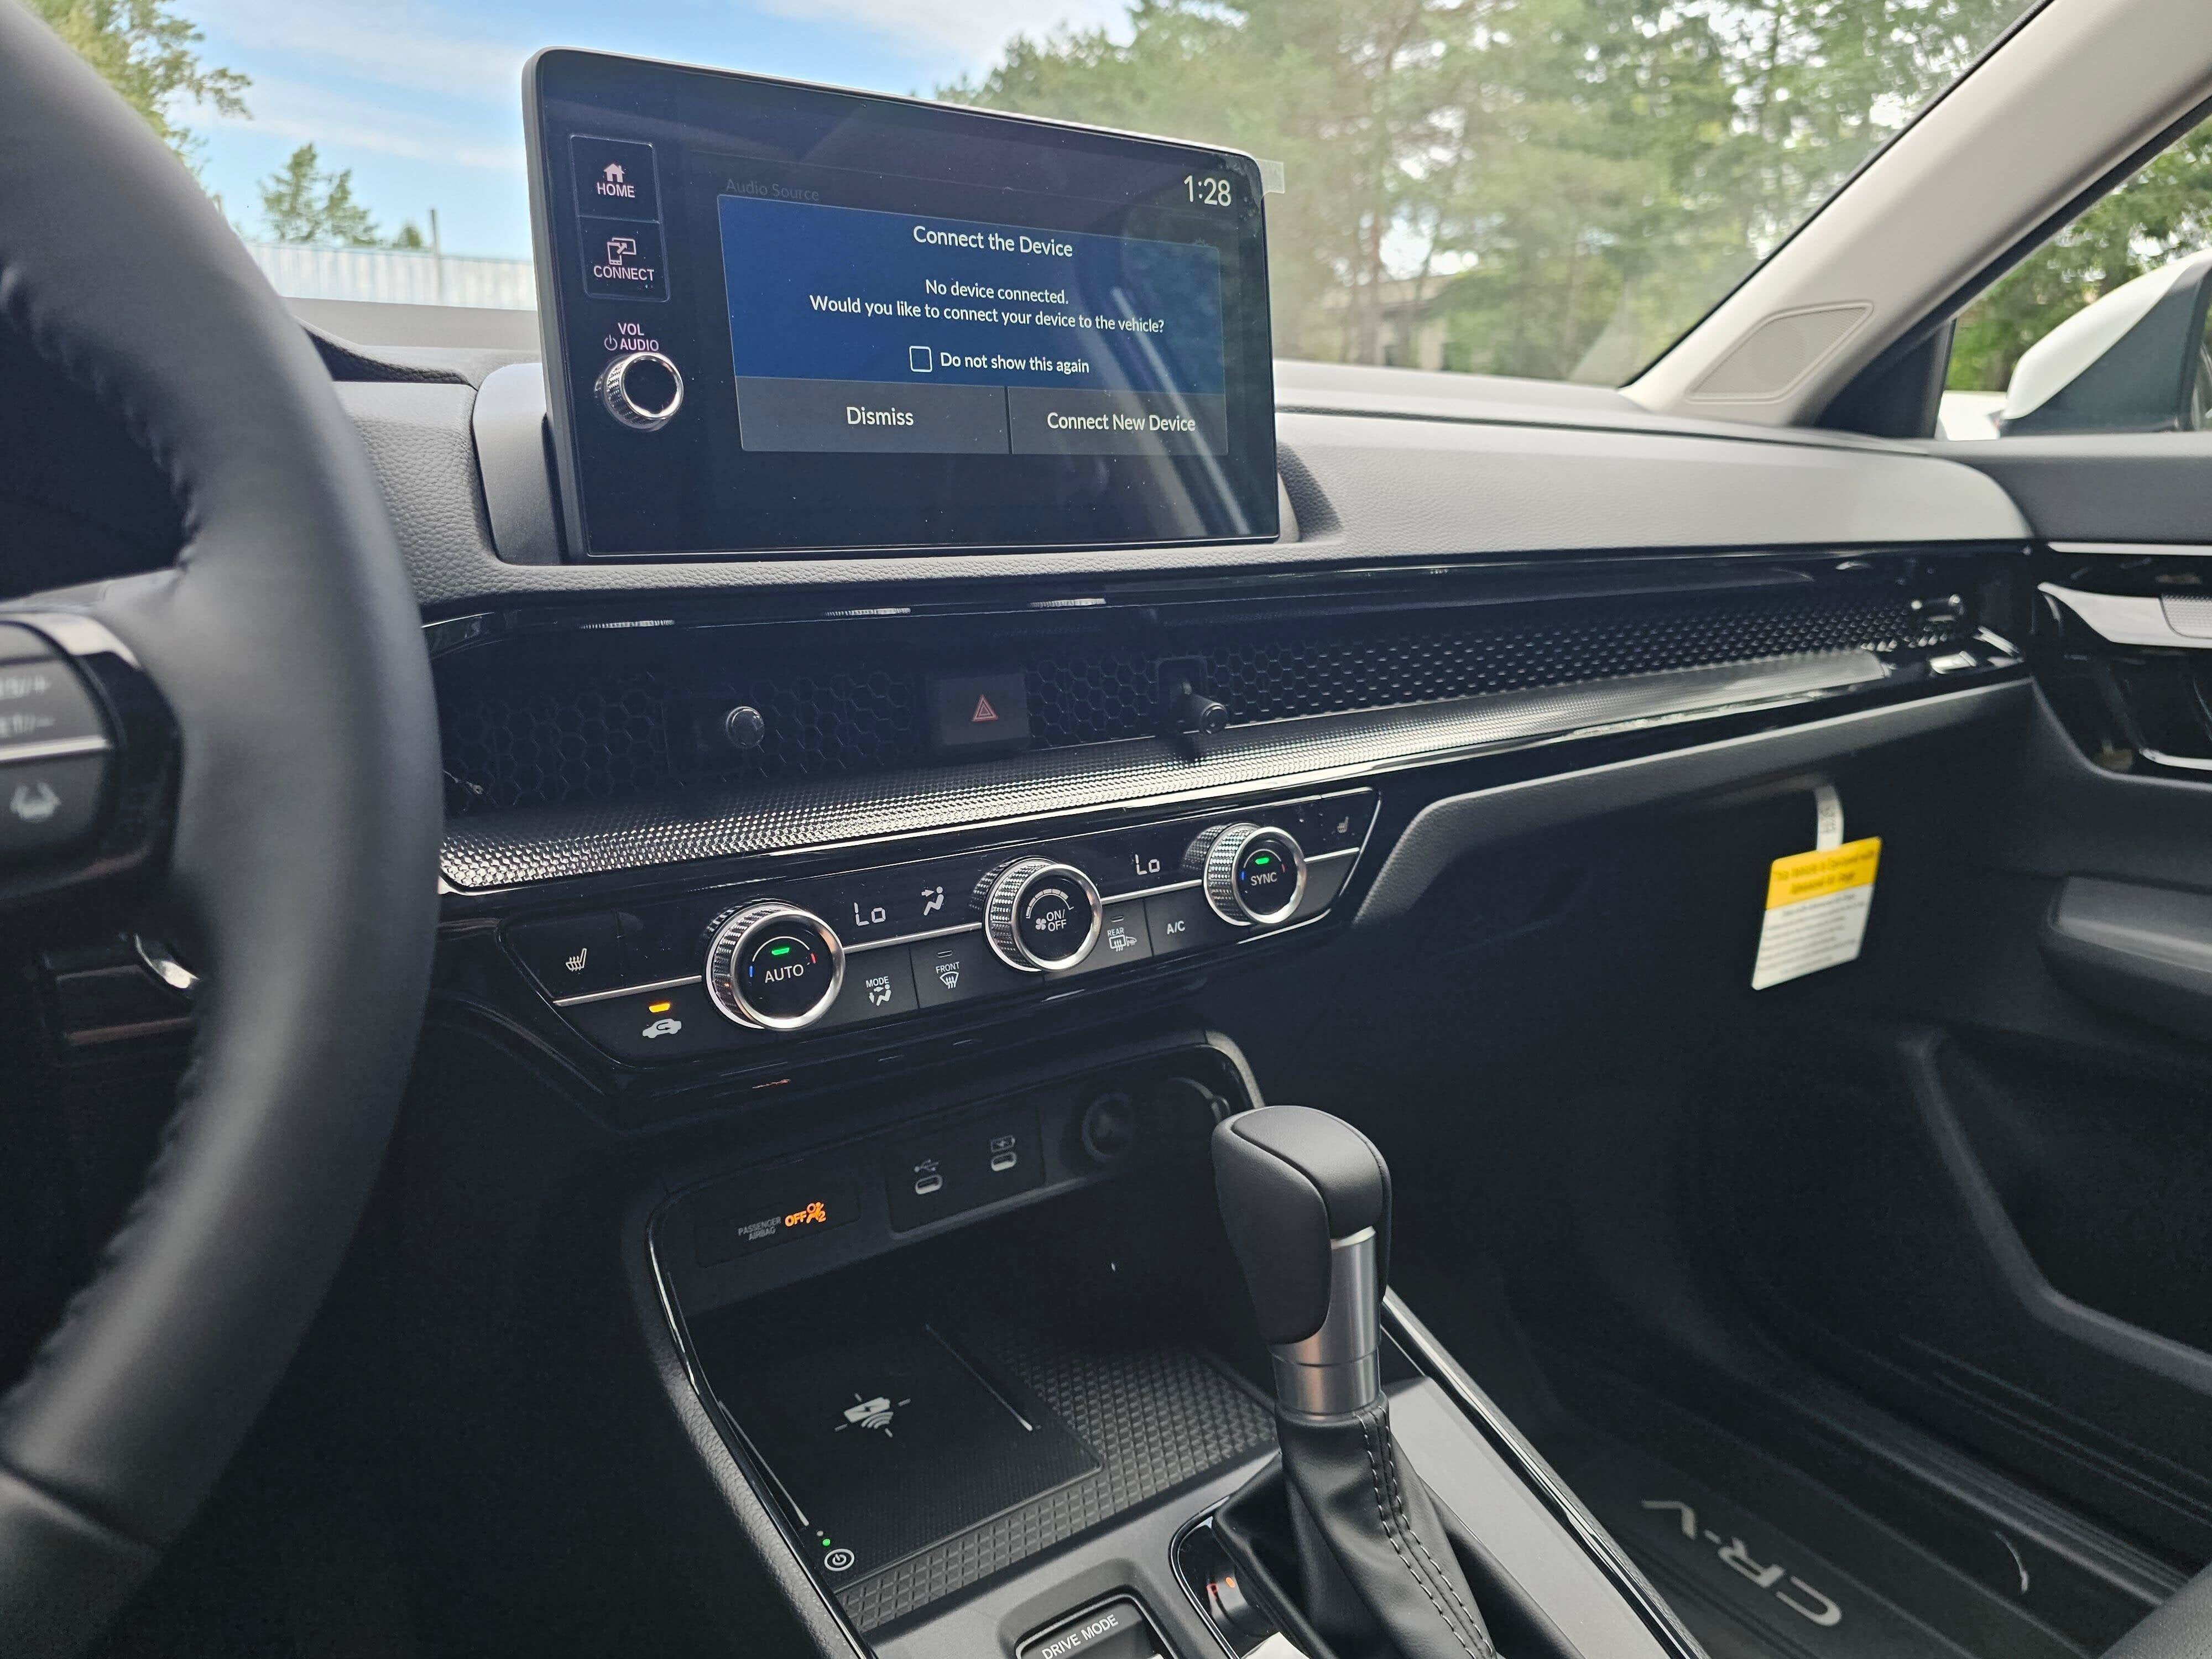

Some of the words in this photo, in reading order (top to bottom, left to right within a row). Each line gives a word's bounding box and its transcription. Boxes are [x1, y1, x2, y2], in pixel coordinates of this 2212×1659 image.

[597, 182, 635, 198] HOME
[1183, 175, 1231, 207] 1:28
[913, 226, 984, 249] Connect
[988, 233, 1015, 251] the
[1020, 236, 1073, 257] Device
[593, 265, 654, 281] CONNECT
[925, 279, 947, 295] No
[951, 281, 994, 299] device
[998, 285, 1069, 305] connected.
[810, 295, 861, 313] Would
[865, 302, 893, 317] you
[897, 301, 921, 318] like
[925, 304, 940, 318] to
[943, 306, 998, 322] connect
[1001, 312, 1031, 326] your
[1035, 310, 1076, 328] device
[1079, 315, 1092, 328] to
[1095, 314, 1115, 330] the
[1118, 317, 1164, 333] vehicle?
[618, 322, 644, 336] VOL
[619, 337, 659, 351] AUDIO
[940, 351, 961, 368] Do
[964, 354, 988, 369] not
[991, 354, 1026, 371] show
[1029, 357, 1053, 372] this
[1056, 358, 1089, 375] again
[847, 407, 914, 426] Dismiss
[1047, 412, 1109, 430] Connect
[1112, 414, 1145, 431] New
[1149, 415, 1196, 432] Device
[1135, 854, 1160, 875] Lo
[1251, 872, 1277, 886] SYNC
[854, 902, 886, 926] Lo
[1046, 909, 1066, 921] ON/
[1047, 919, 1067, 932] OFF
[1108, 927, 1124, 937] REAR
[1167, 920, 1186, 935] A/C
[765, 964, 804, 983] AUTO
[936, 961, 959, 974] FRONT
[866, 976, 889, 988] MODE
[738, 1216, 781, 1236] PASSENGER
[784, 1211, 807, 1227] OFF
[749, 1227, 776, 1241] AIRBAG
[1641, 1500, 1842, 1626] CR-V
[1042, 1634, 1081, 1659] DRIVE
[1081, 1614, 1119, 1640] MODE
